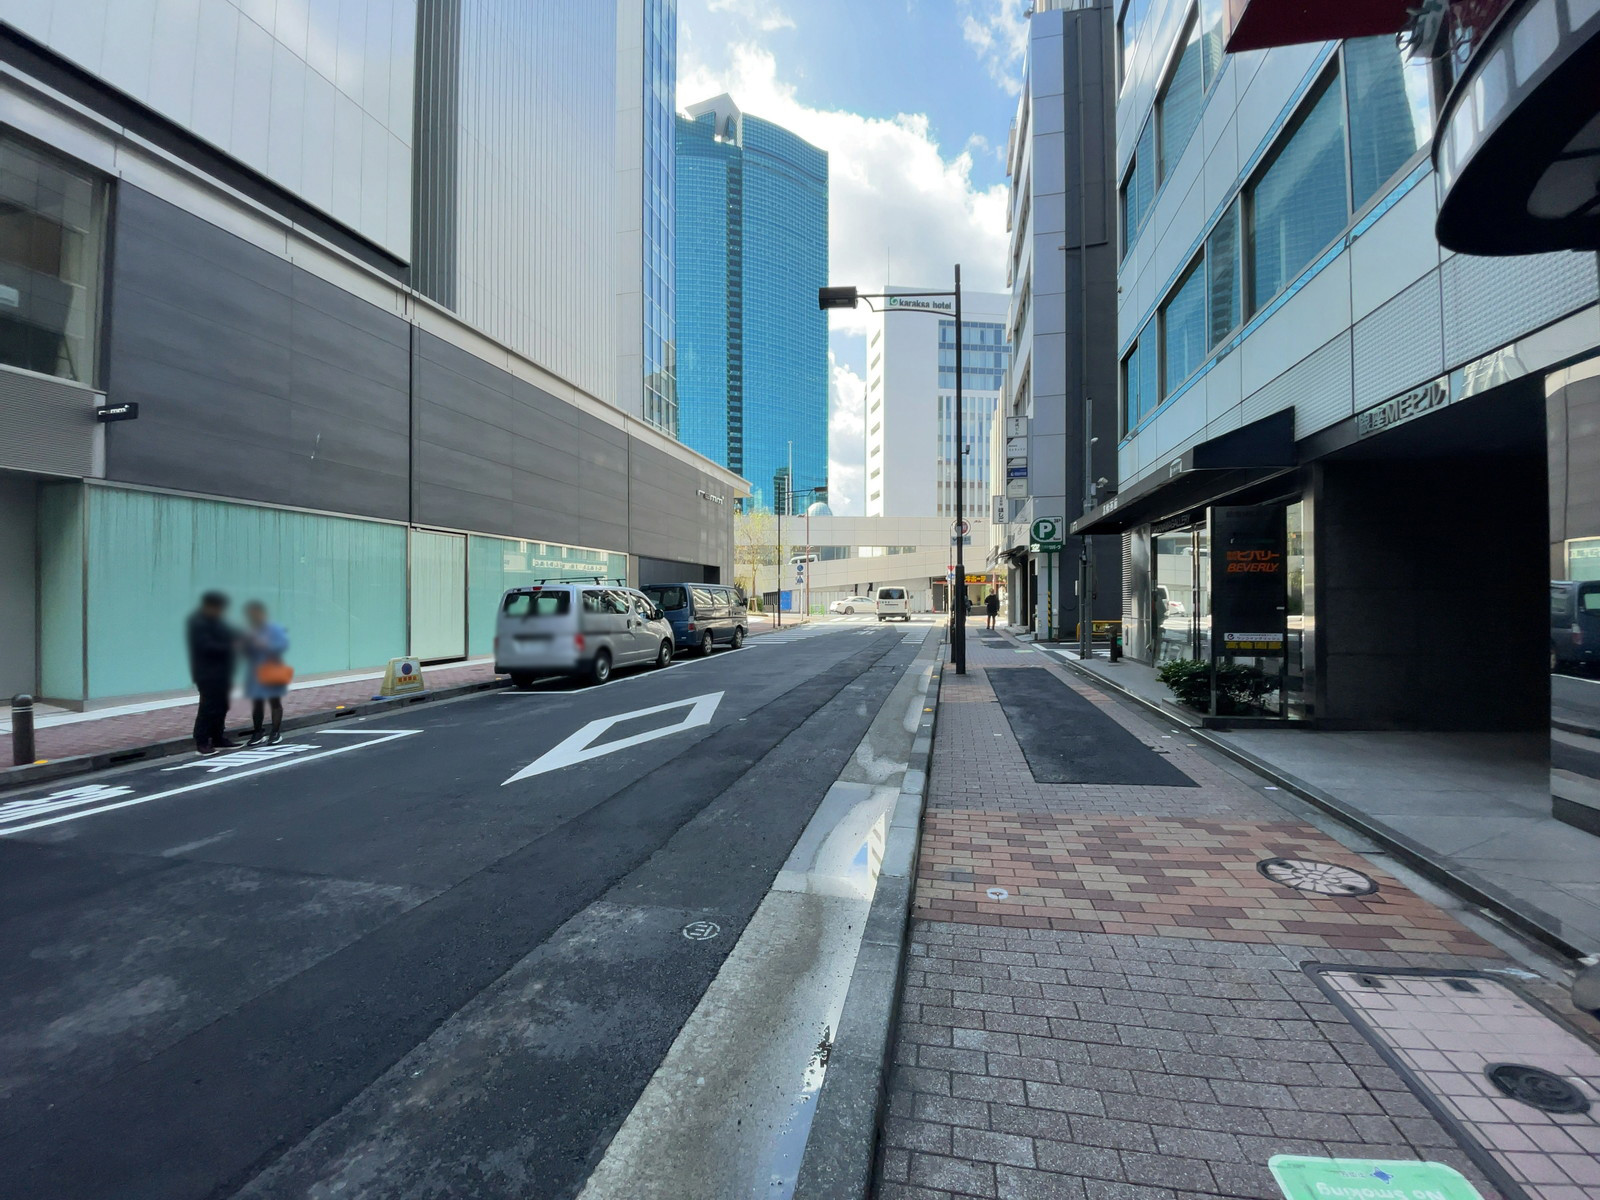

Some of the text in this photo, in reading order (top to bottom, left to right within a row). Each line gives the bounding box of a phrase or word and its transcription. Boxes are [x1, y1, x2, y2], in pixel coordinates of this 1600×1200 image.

[899, 298, 952, 309] karaksa hotel
[1227, 562, 1280, 573] BEVERLY
